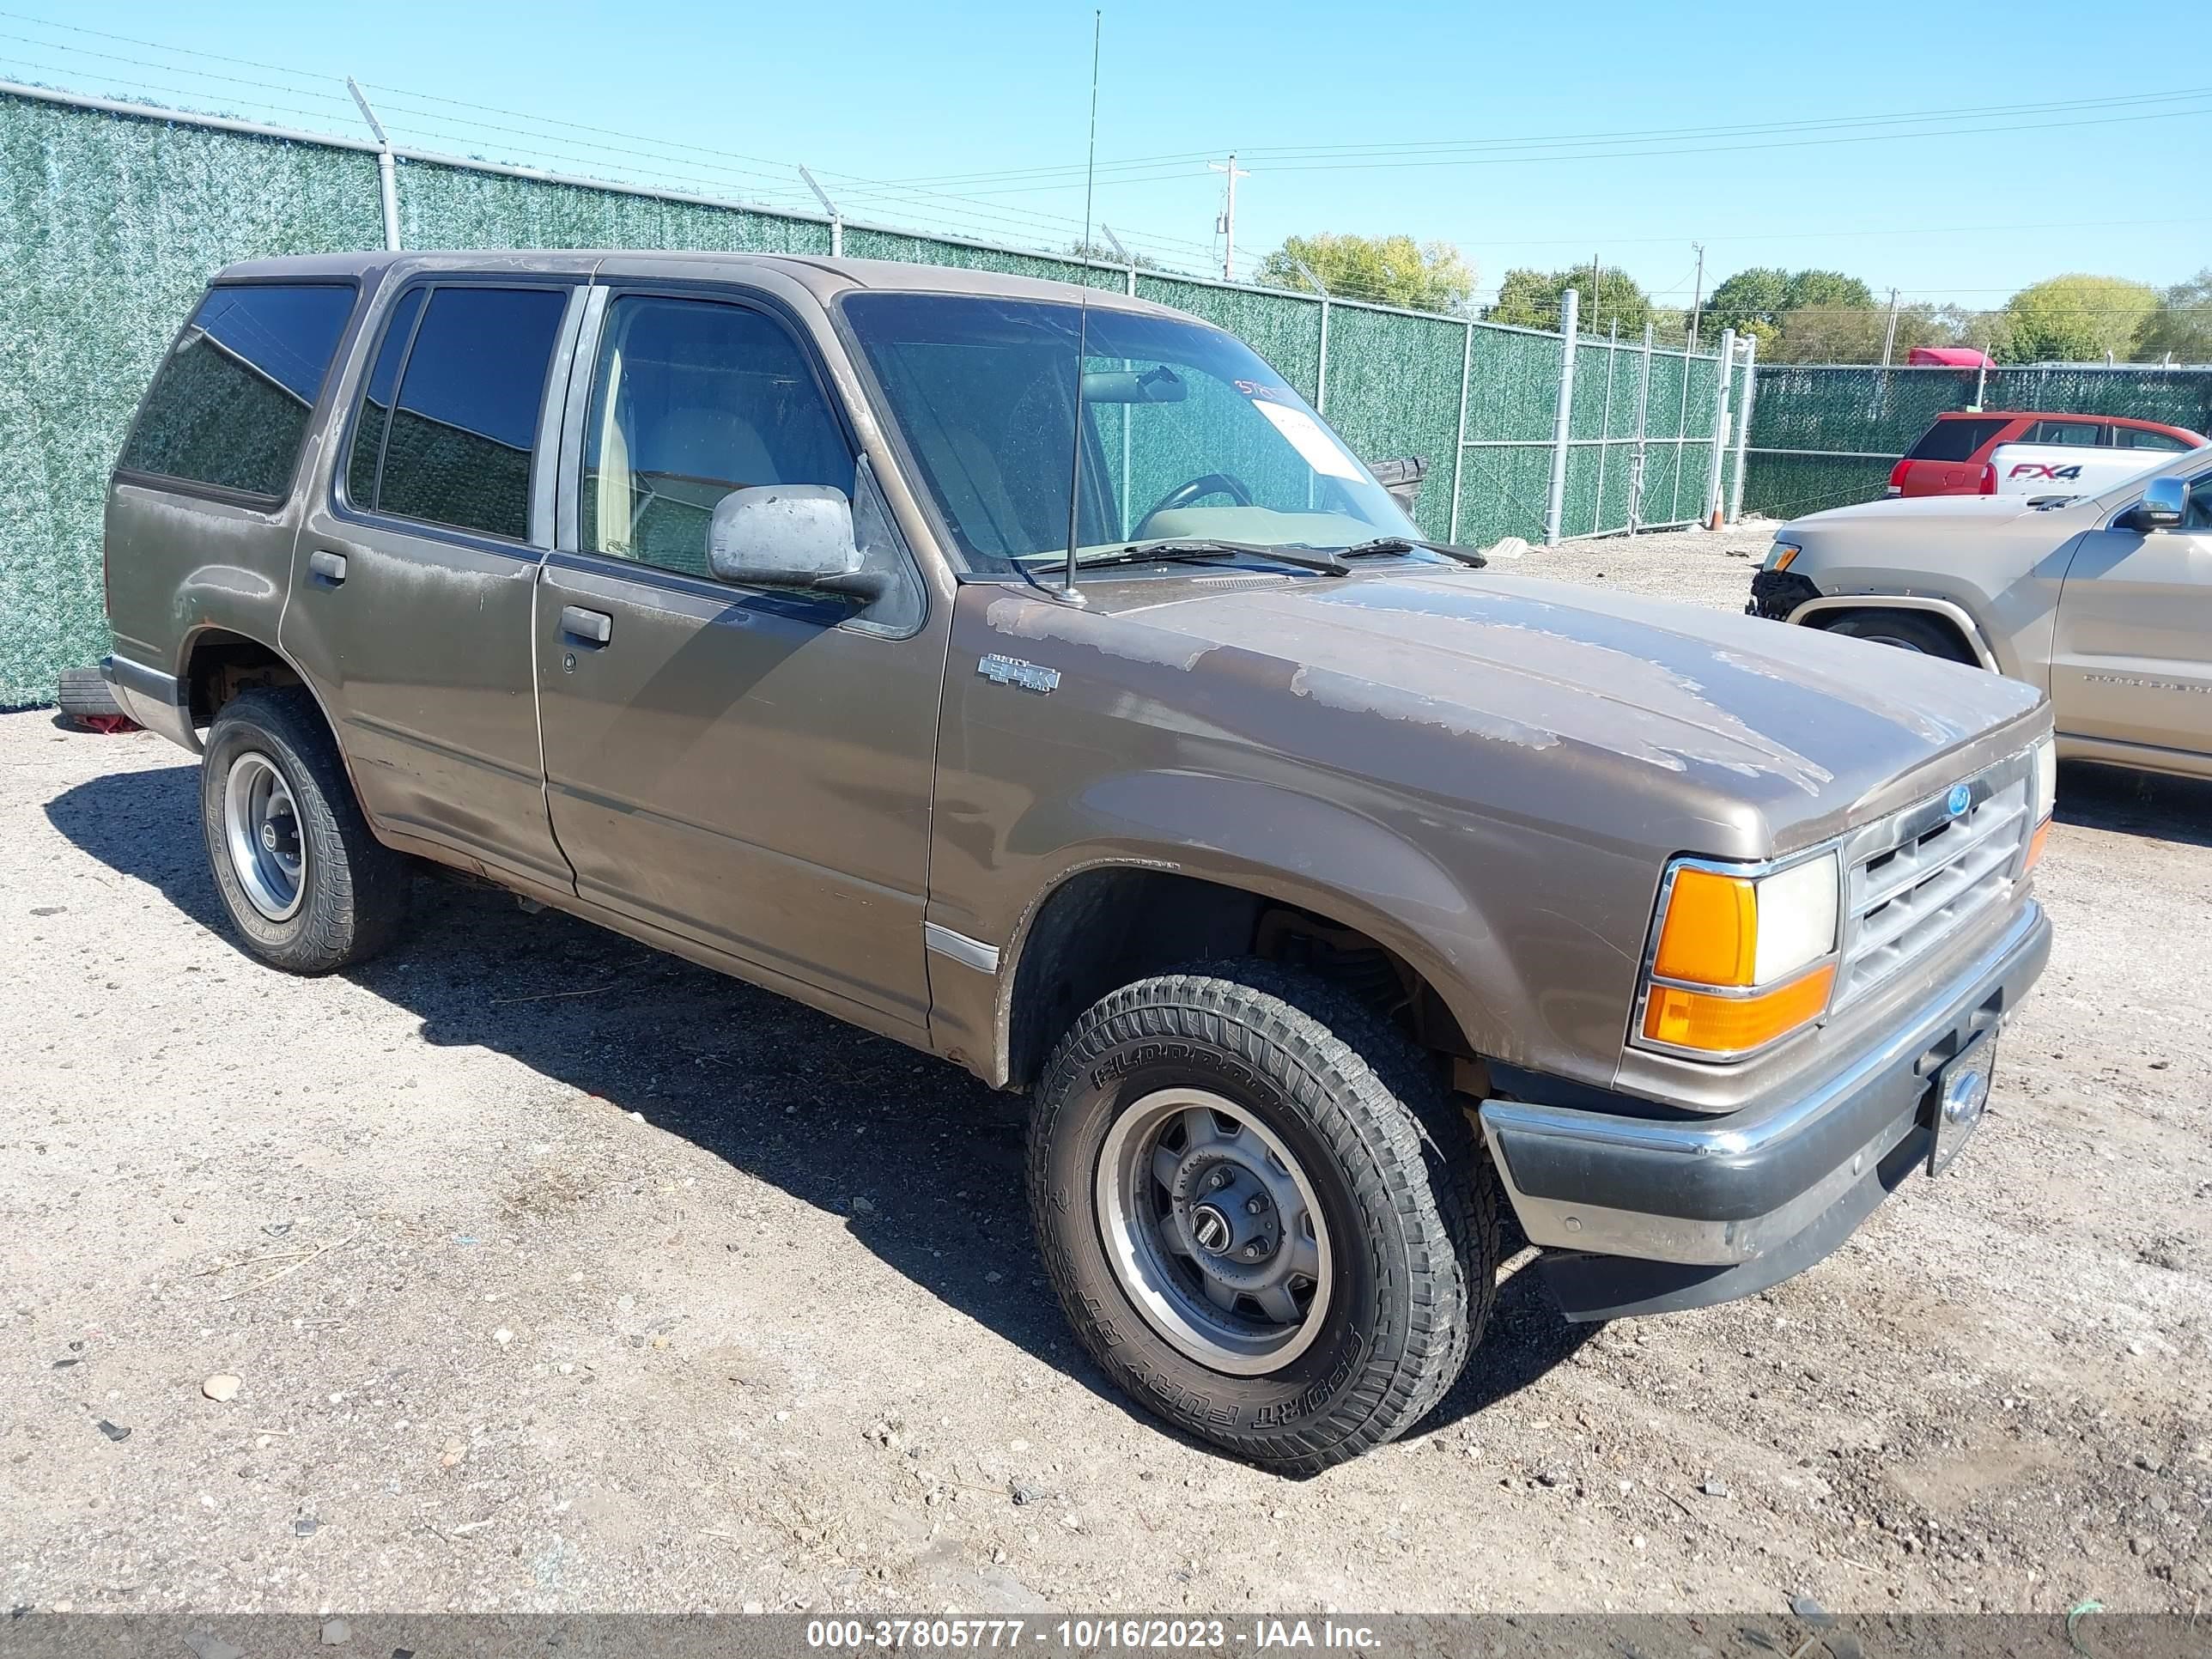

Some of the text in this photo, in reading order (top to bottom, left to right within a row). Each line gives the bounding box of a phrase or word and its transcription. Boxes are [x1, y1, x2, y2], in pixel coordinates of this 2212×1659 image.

[2008, 464, 2083, 481] FX4
[1127, 1352, 1243, 1427] FURY
[1249, 1322, 1364, 1430] SPORT
